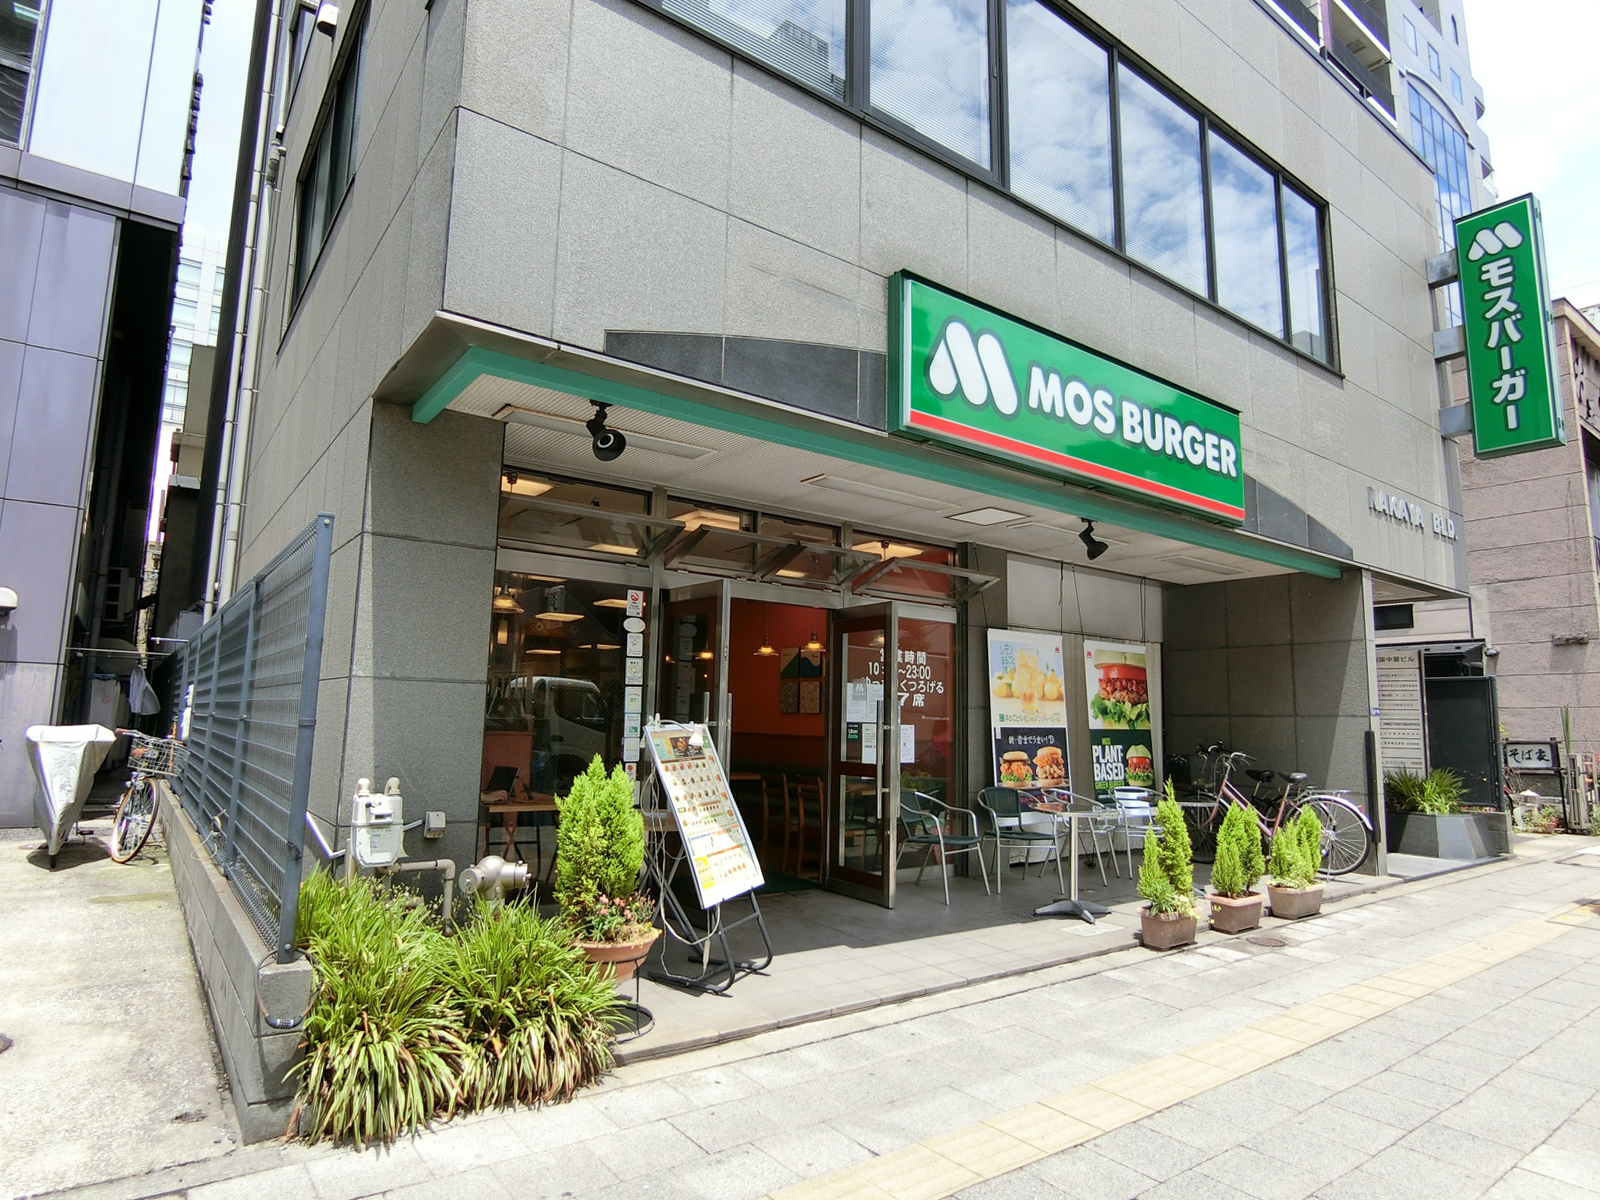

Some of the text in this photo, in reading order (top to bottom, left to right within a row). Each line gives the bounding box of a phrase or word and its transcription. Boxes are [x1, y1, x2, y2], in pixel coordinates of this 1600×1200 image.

[1481, 256, 1526, 429] モスバーガー
[1028, 366, 1238, 478] MOS BURGER
[1093, 763, 1125, 781] BASED
